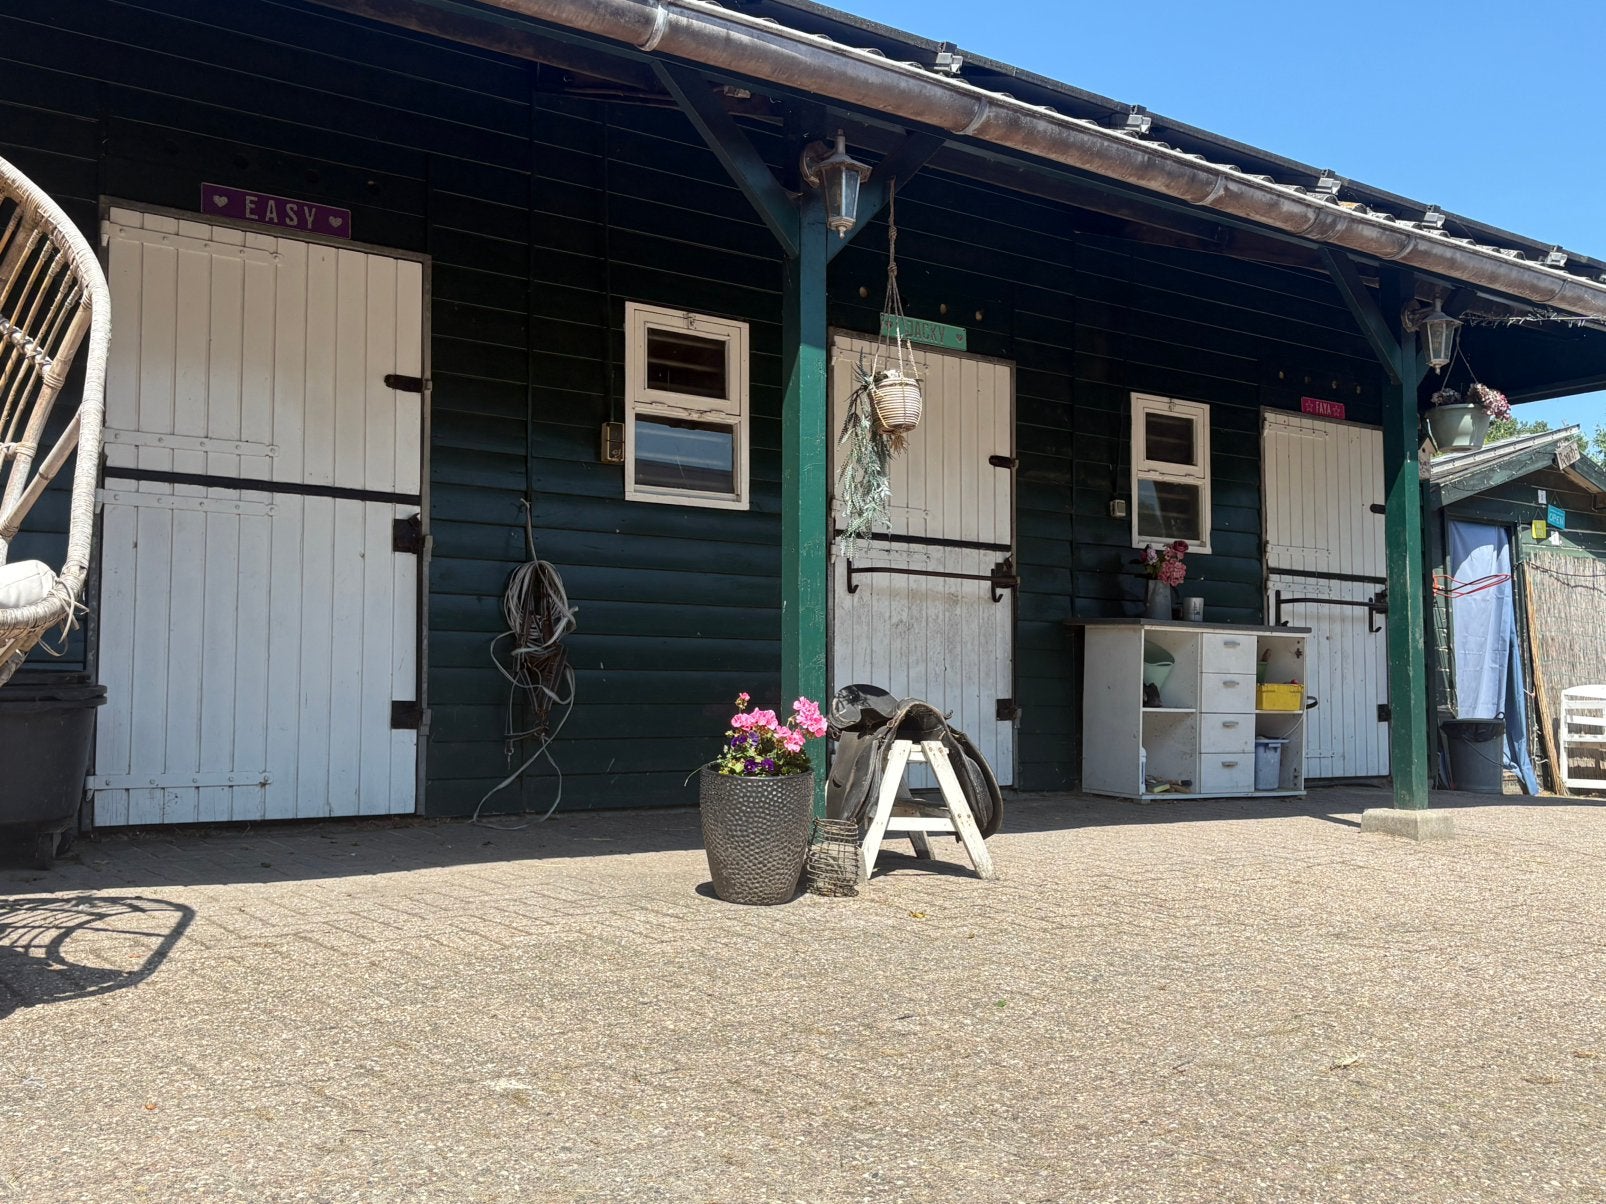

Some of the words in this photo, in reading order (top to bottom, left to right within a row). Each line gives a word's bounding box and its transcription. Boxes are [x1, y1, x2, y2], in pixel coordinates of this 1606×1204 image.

[245, 196, 316, 229] EASY
[904, 319, 944, 344] JACKY
[1315, 401, 1332, 415] FAYA
[1549, 513, 1565, 527] OPEN
